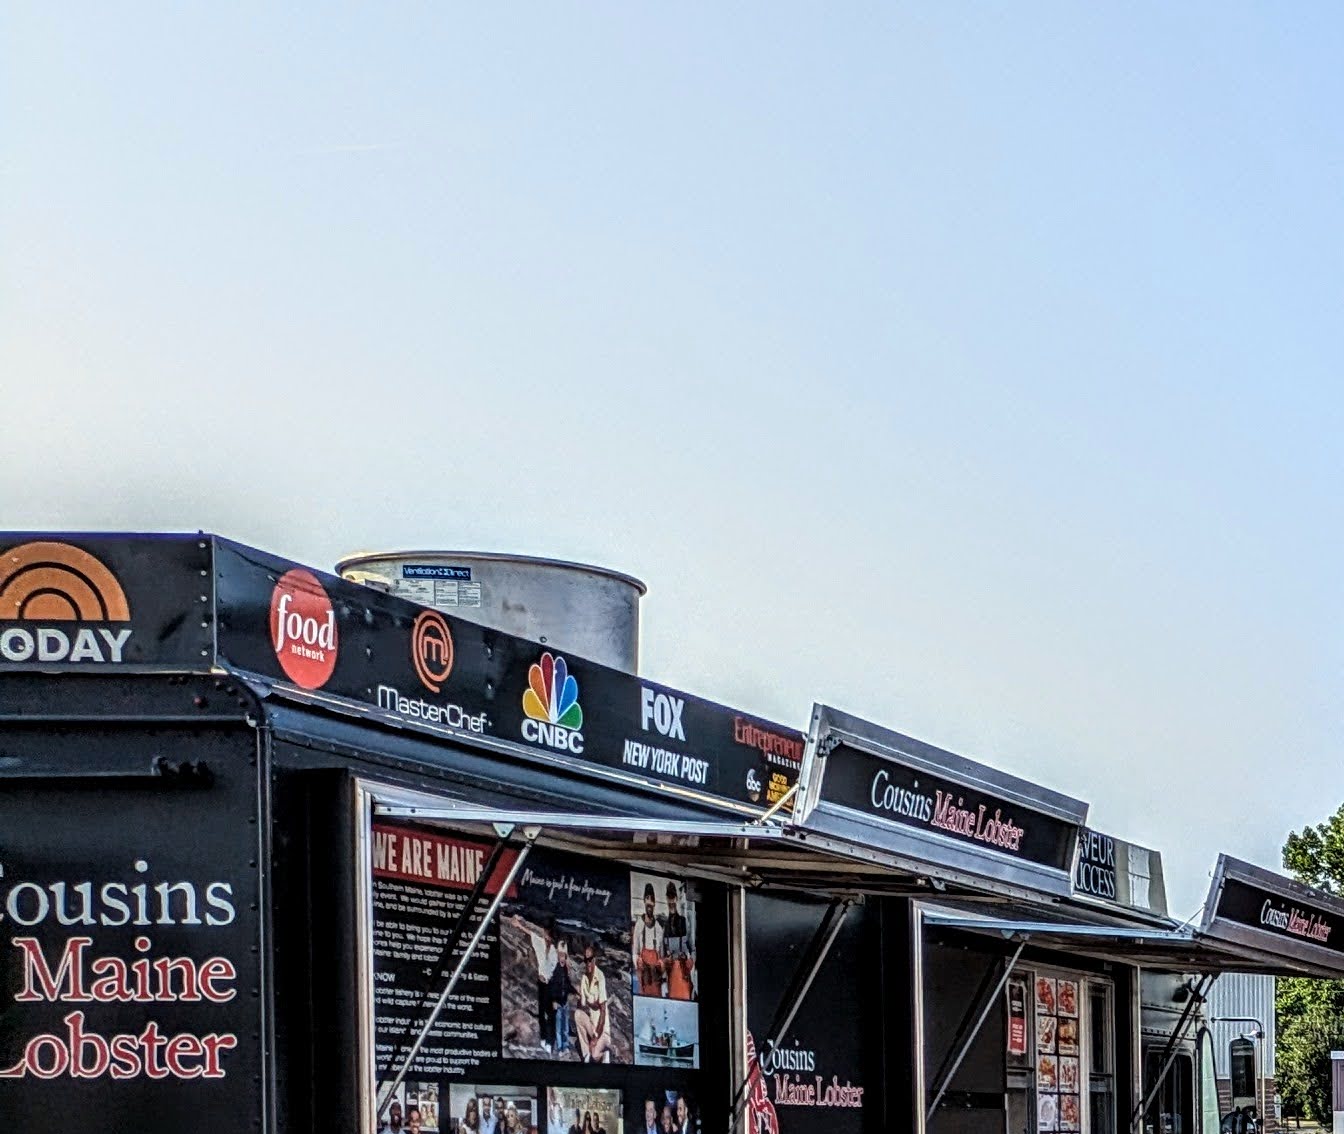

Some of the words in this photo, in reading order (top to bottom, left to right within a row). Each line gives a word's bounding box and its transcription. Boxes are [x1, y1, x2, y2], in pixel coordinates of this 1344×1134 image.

[275, 594, 337, 652] food
[291, 644, 326, 663] network
[377, 685, 489, 734] MasterChef
[640, 686, 686, 742] FOX
[520, 720, 585, 754] CNBC
[622, 739, 651, 769] NEW
[650, 743, 679, 777] YORK
[680, 755, 710, 785] POST
[871, 769, 933, 824] Cousins
[930, 790, 977, 840] Maine
[974, 802, 1024, 851] Lobster
[372, 831, 398, 872] WE
[401, 836, 432, 878] ARE
[0, 860, 236, 926] ousins
[11, 936, 237, 1002] Maine
[760, 1039, 815, 1076] Cousins
[774, 1073, 816, 1105] Maine
[815, 1075, 864, 1108] Lobster
